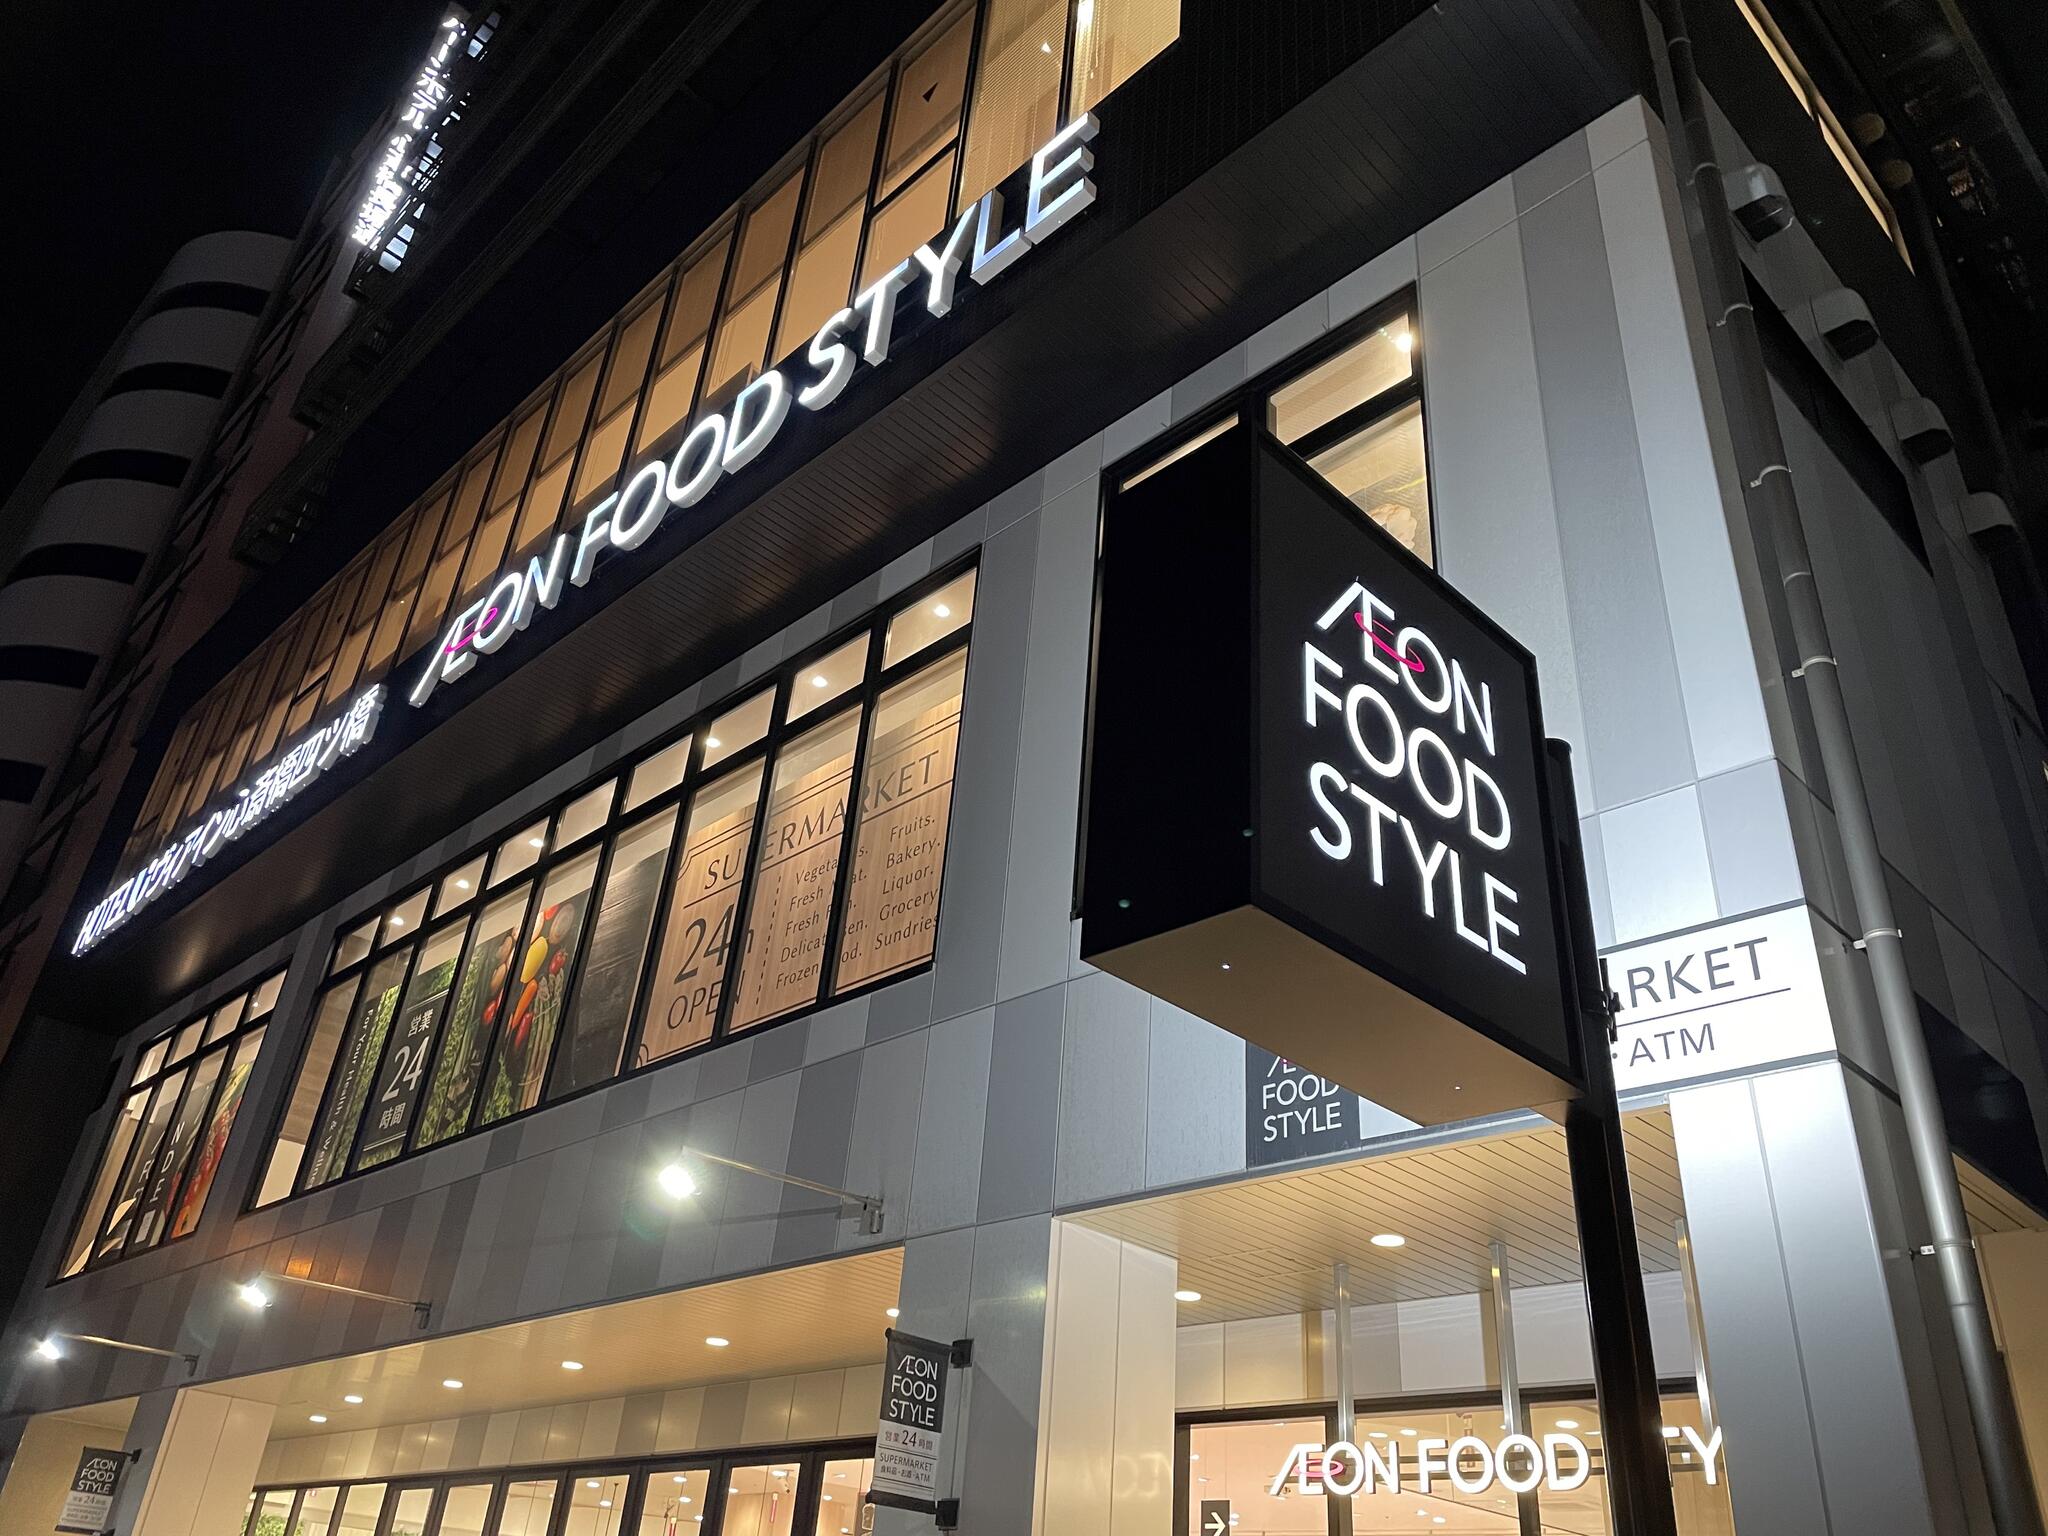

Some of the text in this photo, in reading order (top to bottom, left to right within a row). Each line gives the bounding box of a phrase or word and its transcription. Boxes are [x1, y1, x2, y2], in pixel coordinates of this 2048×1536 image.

[570, 369, 786, 583] FOOD
[799, 111, 1092, 405] STYLE
[1304, 641, 1512, 851] FOOD
[890, 814, 936, 844] Fruits.
[886, 840, 941, 870] Bakery.
[1309, 761, 1528, 976] STYLE
[882, 866, 934, 895] Liquor.
[789, 885, 824, 913] Fresh
[71, 877, 136, 955] HOTEL
[785, 909, 820, 937] Fresh
[776, 962, 819, 990] Frozen
[1620, 936, 1768, 1010] RKET
[408, 1008, 434, 1038] 営業
[381, 1036, 430, 1102] 24
[1262, 1074, 1340, 1110] FOOD
[379, 1102, 406, 1129] 時間
[1263, 1101, 1342, 1142] STYLE
[891, 1374, 937, 1402] FOOD
[889, 1398, 936, 1427] STYLE
[901, 1429, 917, 1447] 24
[80, 1468, 115, 1483] FOOD
[879, 1452, 934, 1472] SUPERMARKET
[1417, 1433, 1591, 1494] FOOD
[77, 1479, 112, 1494] STYLE
